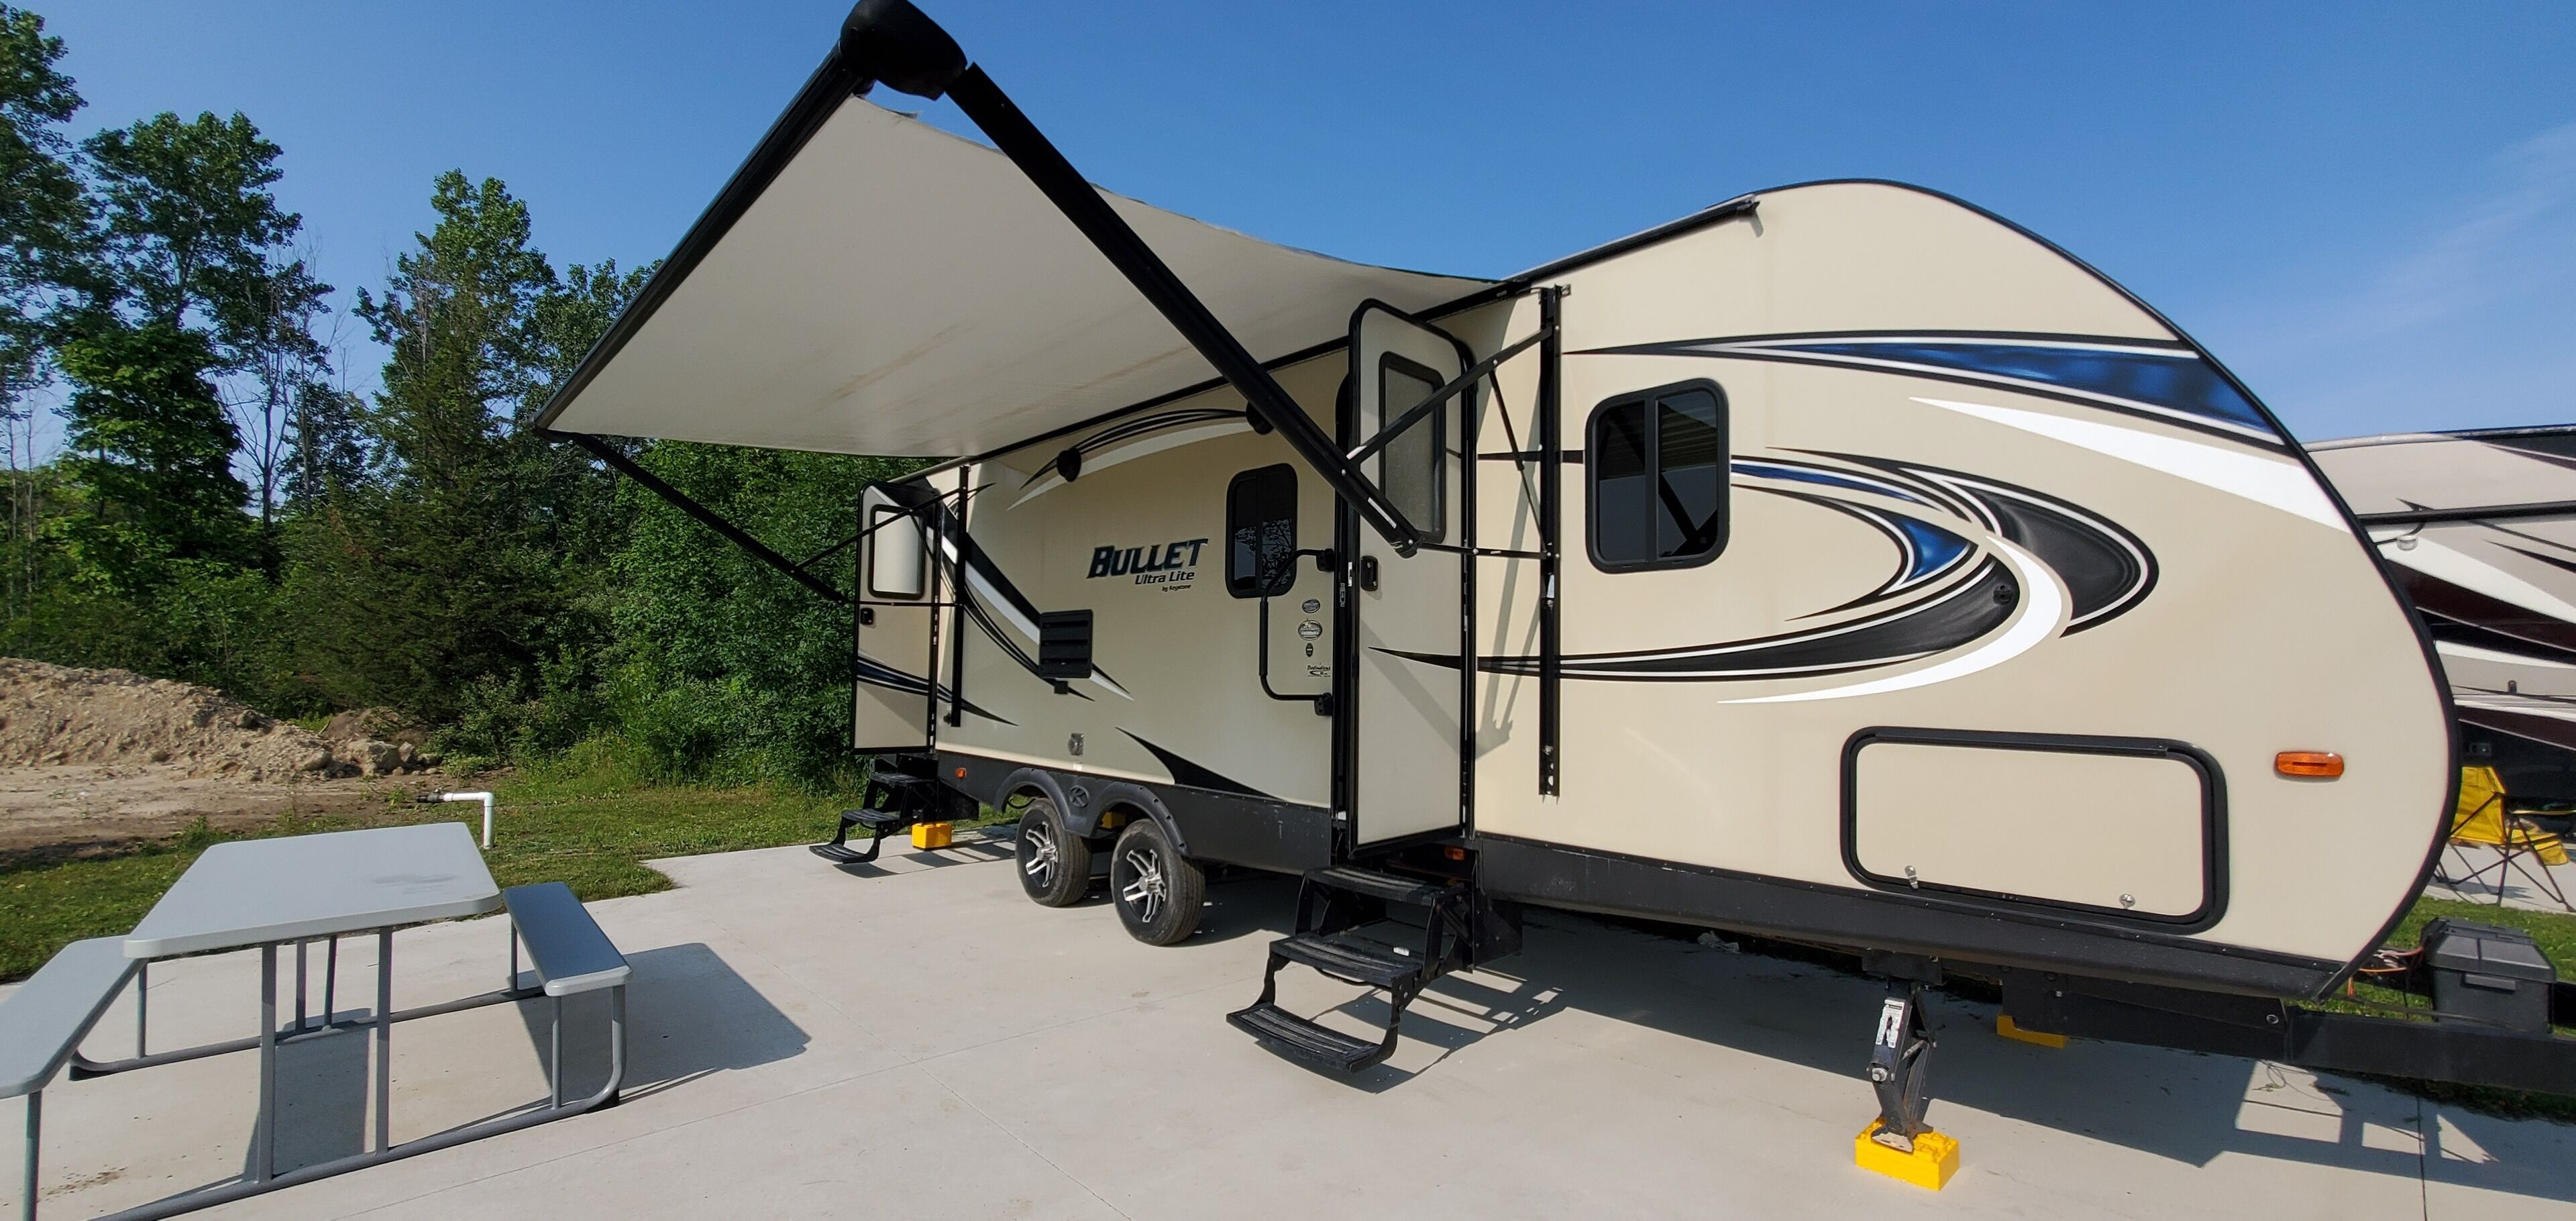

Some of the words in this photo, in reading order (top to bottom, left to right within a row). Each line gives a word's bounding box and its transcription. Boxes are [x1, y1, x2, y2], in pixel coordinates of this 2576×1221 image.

[1086, 538, 1209, 578] BULLET
[1135, 574, 1167, 585] Ultra
[1169, 571, 1195, 582] Lite
